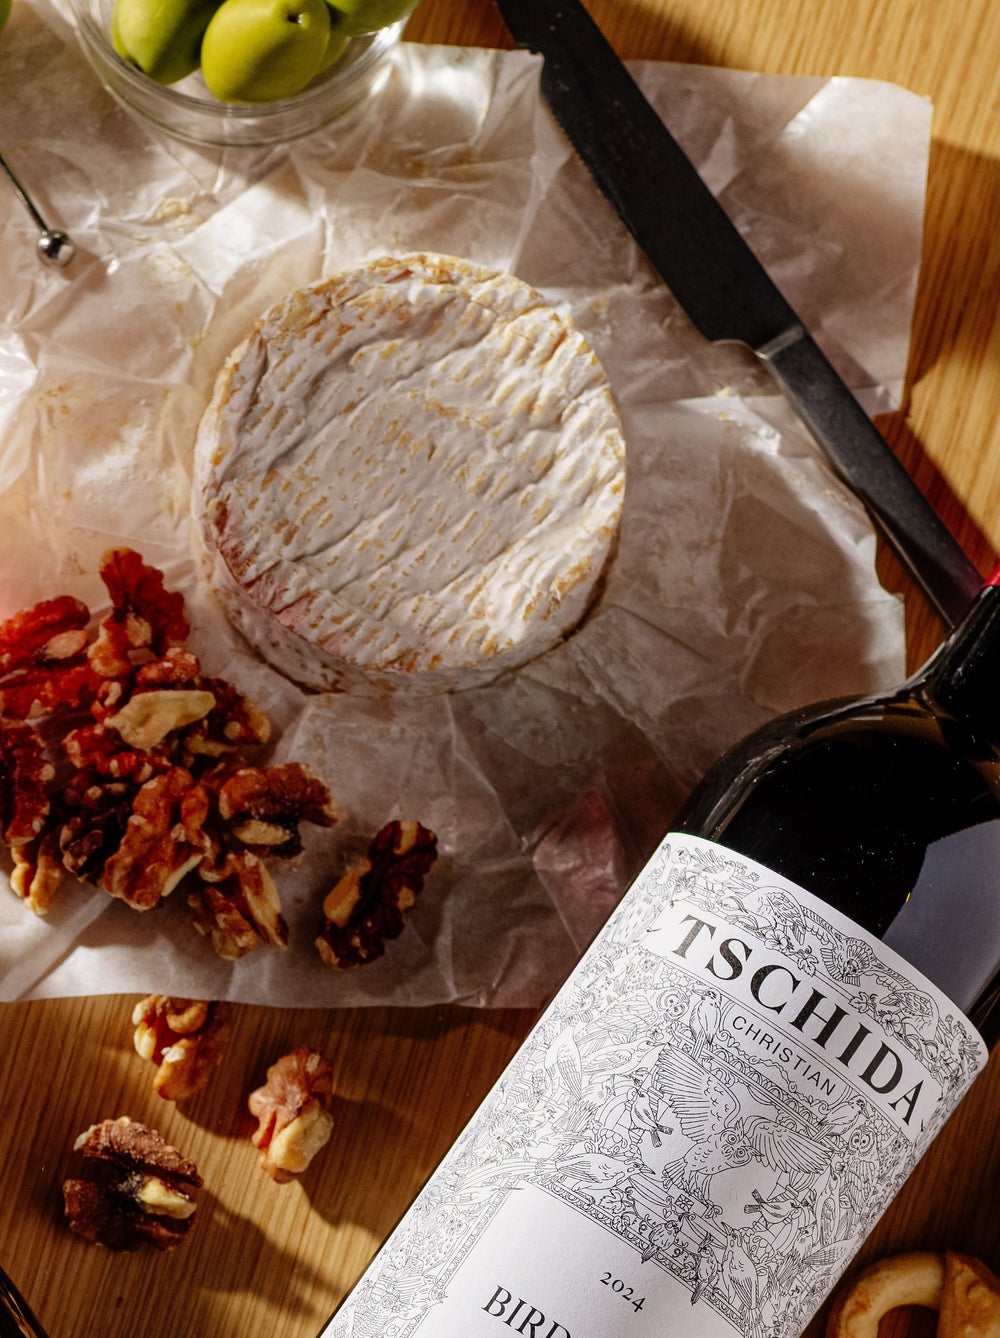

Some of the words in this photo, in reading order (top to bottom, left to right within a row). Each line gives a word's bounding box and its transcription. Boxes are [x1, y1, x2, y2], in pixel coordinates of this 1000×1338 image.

[671, 913, 925, 1126] TSCHIDA
[732, 1015, 837, 1097] CHRISTIAN
[599, 1271, 647, 1314] 2024
